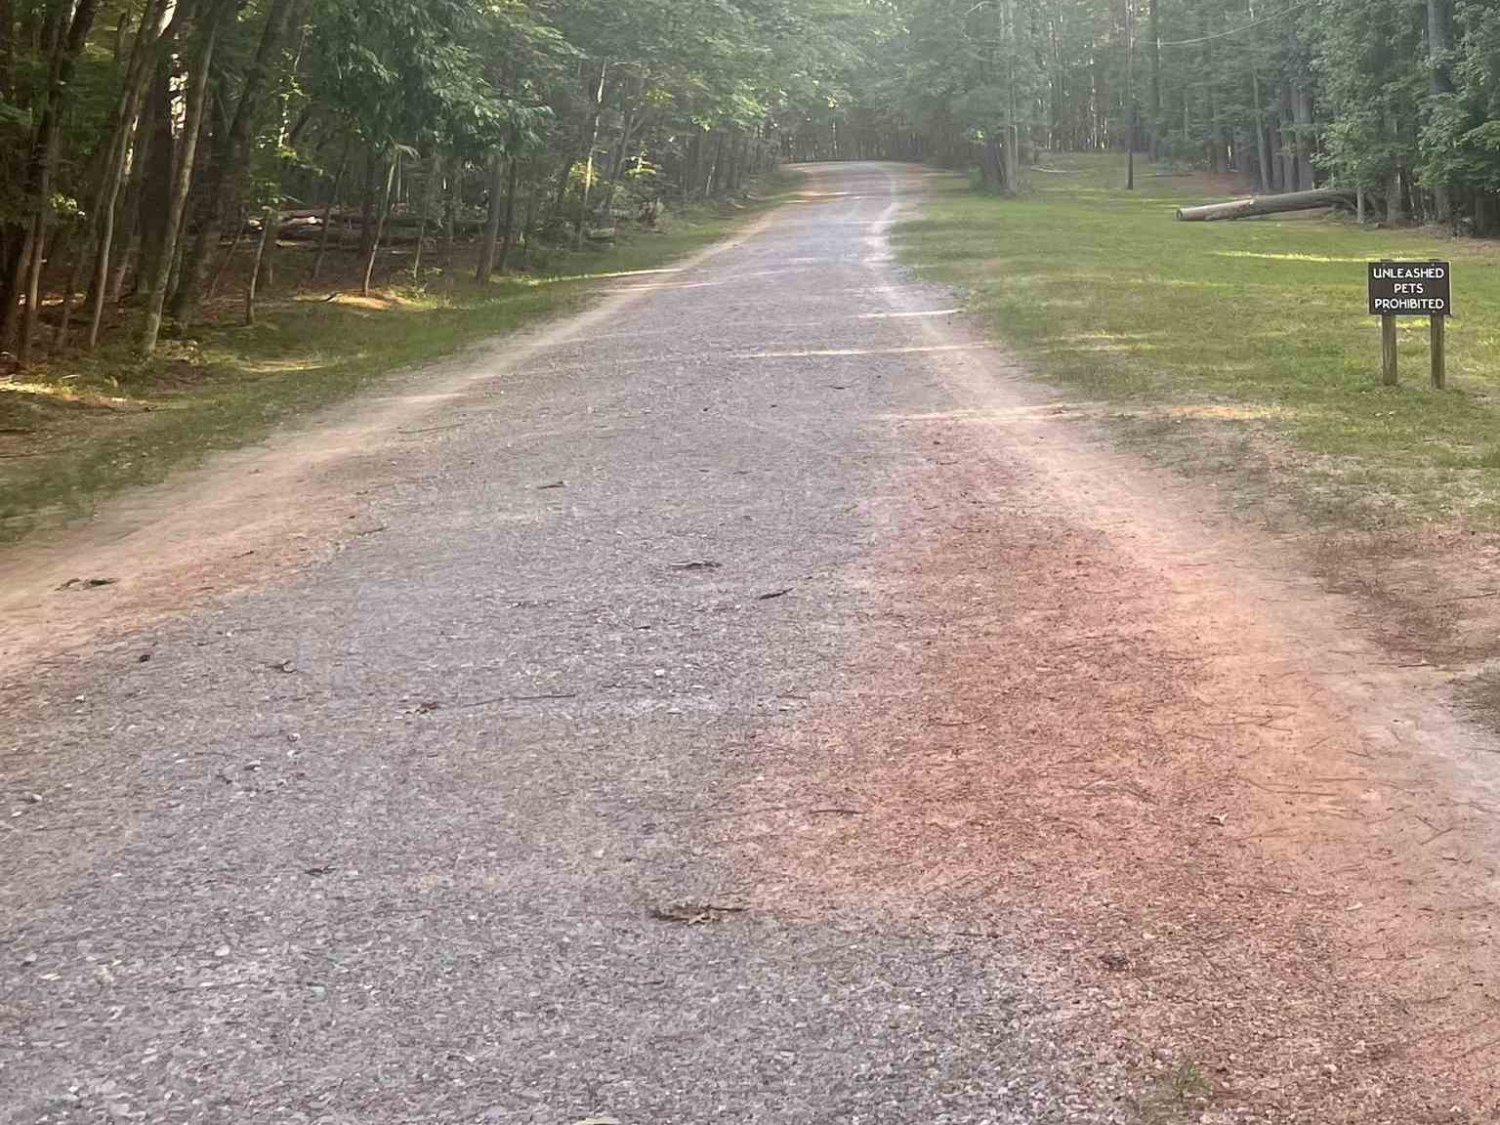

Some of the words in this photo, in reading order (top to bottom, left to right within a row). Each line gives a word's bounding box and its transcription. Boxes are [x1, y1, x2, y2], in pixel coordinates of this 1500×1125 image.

[1373, 268, 1445, 279] UNLEASHED
[1394, 283, 1424, 294] PETS
[1374, 298, 1445, 310] PROHIBITED
